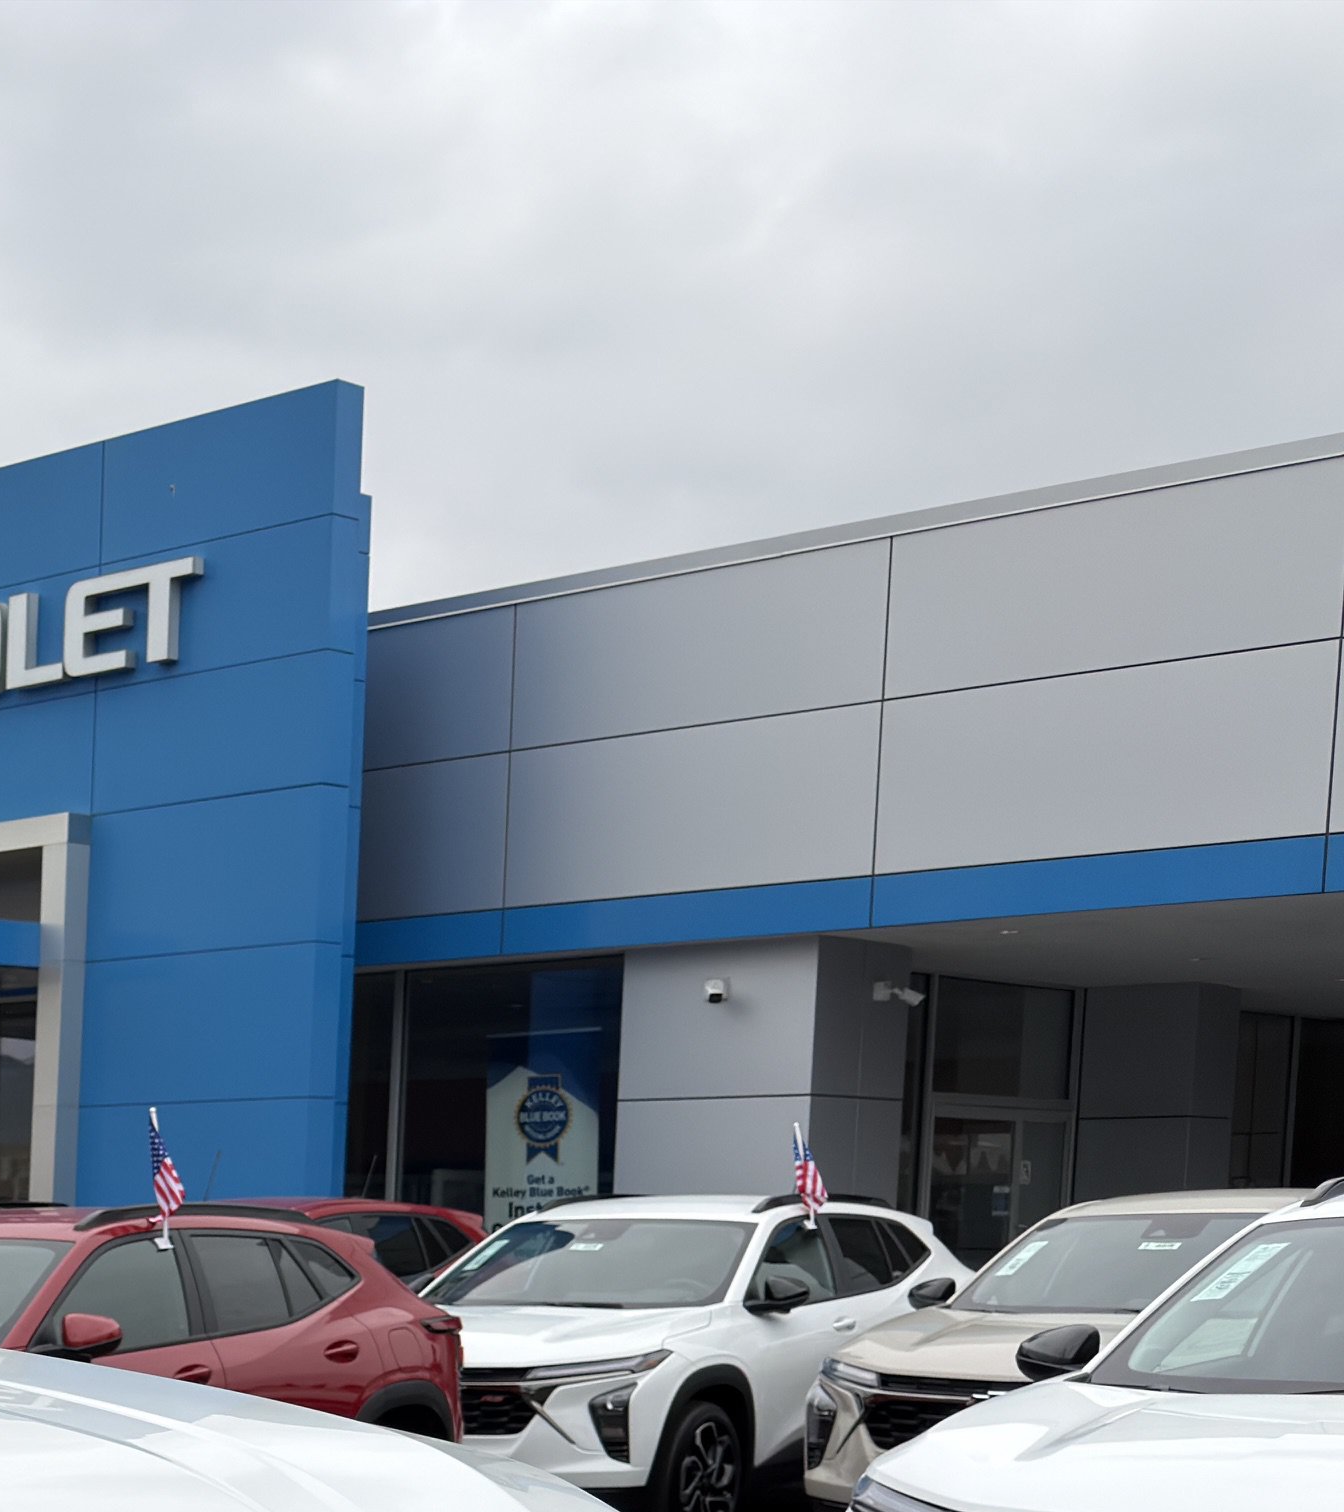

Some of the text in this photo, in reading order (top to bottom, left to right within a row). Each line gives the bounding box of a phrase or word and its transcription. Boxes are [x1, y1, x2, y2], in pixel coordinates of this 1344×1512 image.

[526, 1174, 545, 1185] Get
[492, 1187, 526, 1198] Kelley
[529, 1186, 554, 1197] Blue
